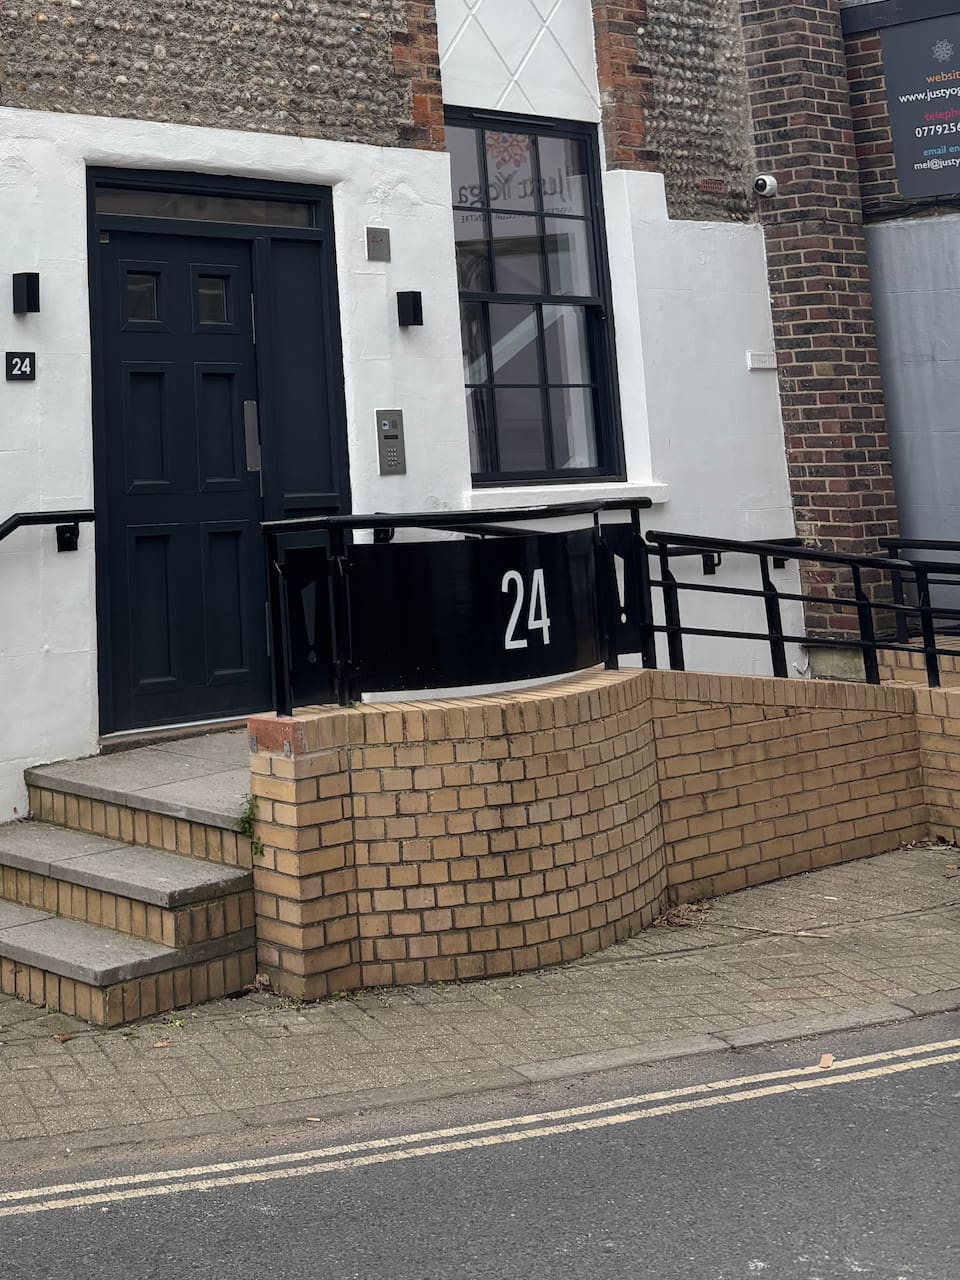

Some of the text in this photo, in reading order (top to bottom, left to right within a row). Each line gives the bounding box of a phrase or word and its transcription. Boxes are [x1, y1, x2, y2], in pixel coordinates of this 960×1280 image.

[923, 146, 947, 156] email
[12, 357, 31, 375] 24
[501, 568, 551, 650] 24
